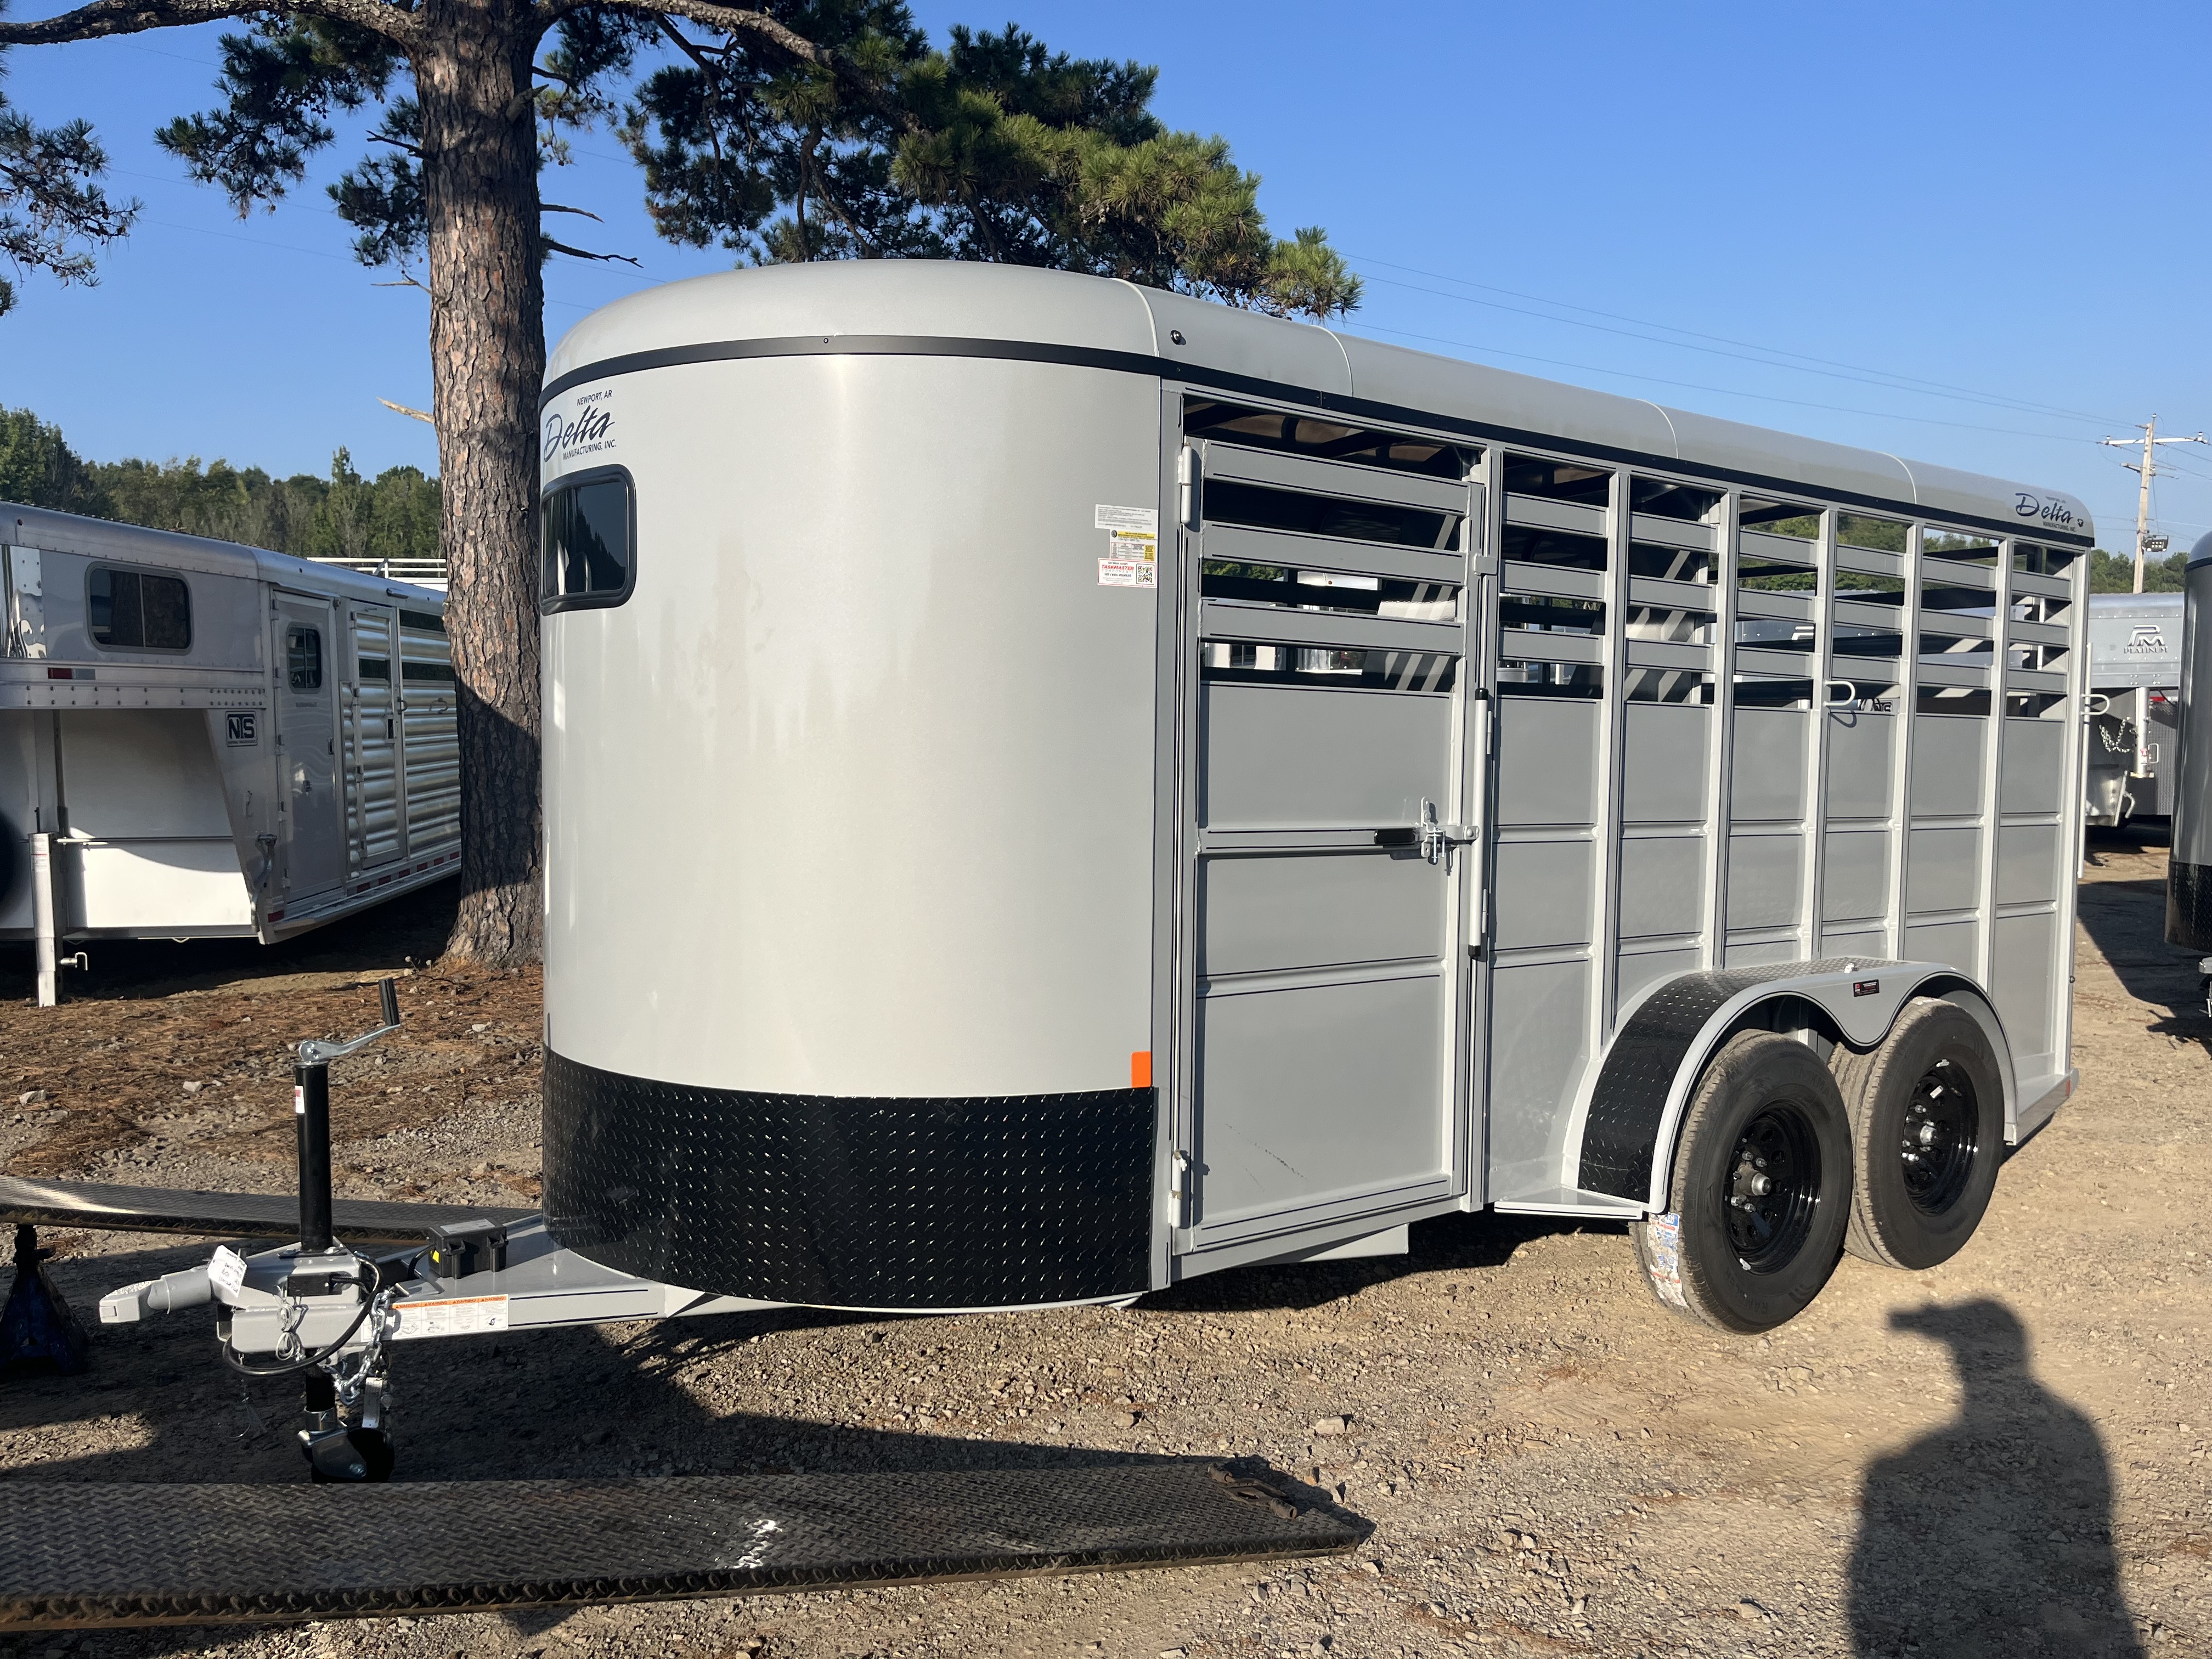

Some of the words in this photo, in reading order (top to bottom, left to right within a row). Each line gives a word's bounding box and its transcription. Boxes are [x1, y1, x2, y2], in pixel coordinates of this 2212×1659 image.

[577, 392, 603, 406] NEWPORT,
[603, 390, 612, 398] AR
[544, 405, 616, 462] Delta
[563, 442, 603, 460] MANUFACTURING,
[604, 439, 617, 449] INC.
[2015, 493, 2074, 524] Delta
[2124, 646, 2168, 654] PLATINUM
